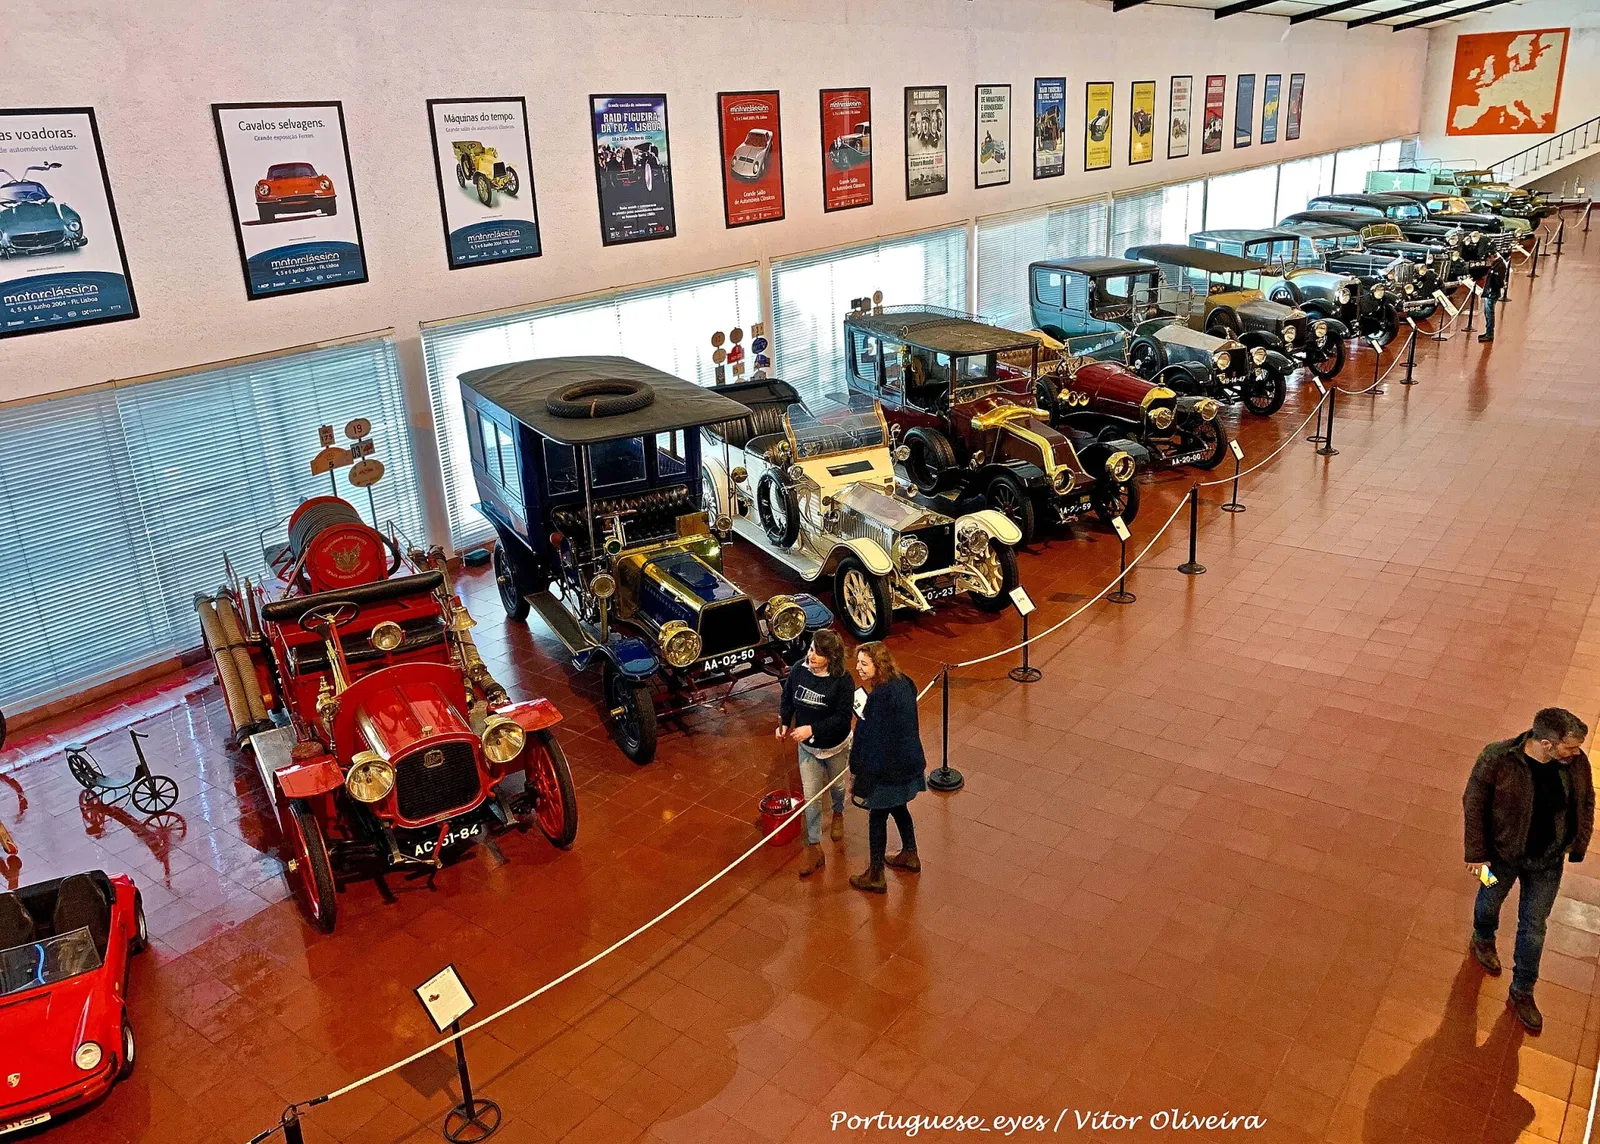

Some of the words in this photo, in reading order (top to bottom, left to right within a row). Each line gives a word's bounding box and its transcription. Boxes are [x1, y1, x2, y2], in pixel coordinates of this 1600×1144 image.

[443, 113, 479, 125] Máquinas
[479, 112, 490, 122] do
[490, 112, 516, 123] tempo.
[603, 113, 622, 123] RAID
[623, 112, 660, 122] FIGUEIRA
[238, 119, 276, 131] Cavalos
[278, 118, 326, 131] selvagens.
[600, 123, 612, 133] DA
[613, 123, 629, 132] FOZ
[634, 122, 662, 132] LISBOA
[15, 126, 77, 140] voadoras.
[3, 284, 99, 304] motorclássico
[33, 302, 51, 310] Junho
[704, 648, 755, 671] AA-02-50
